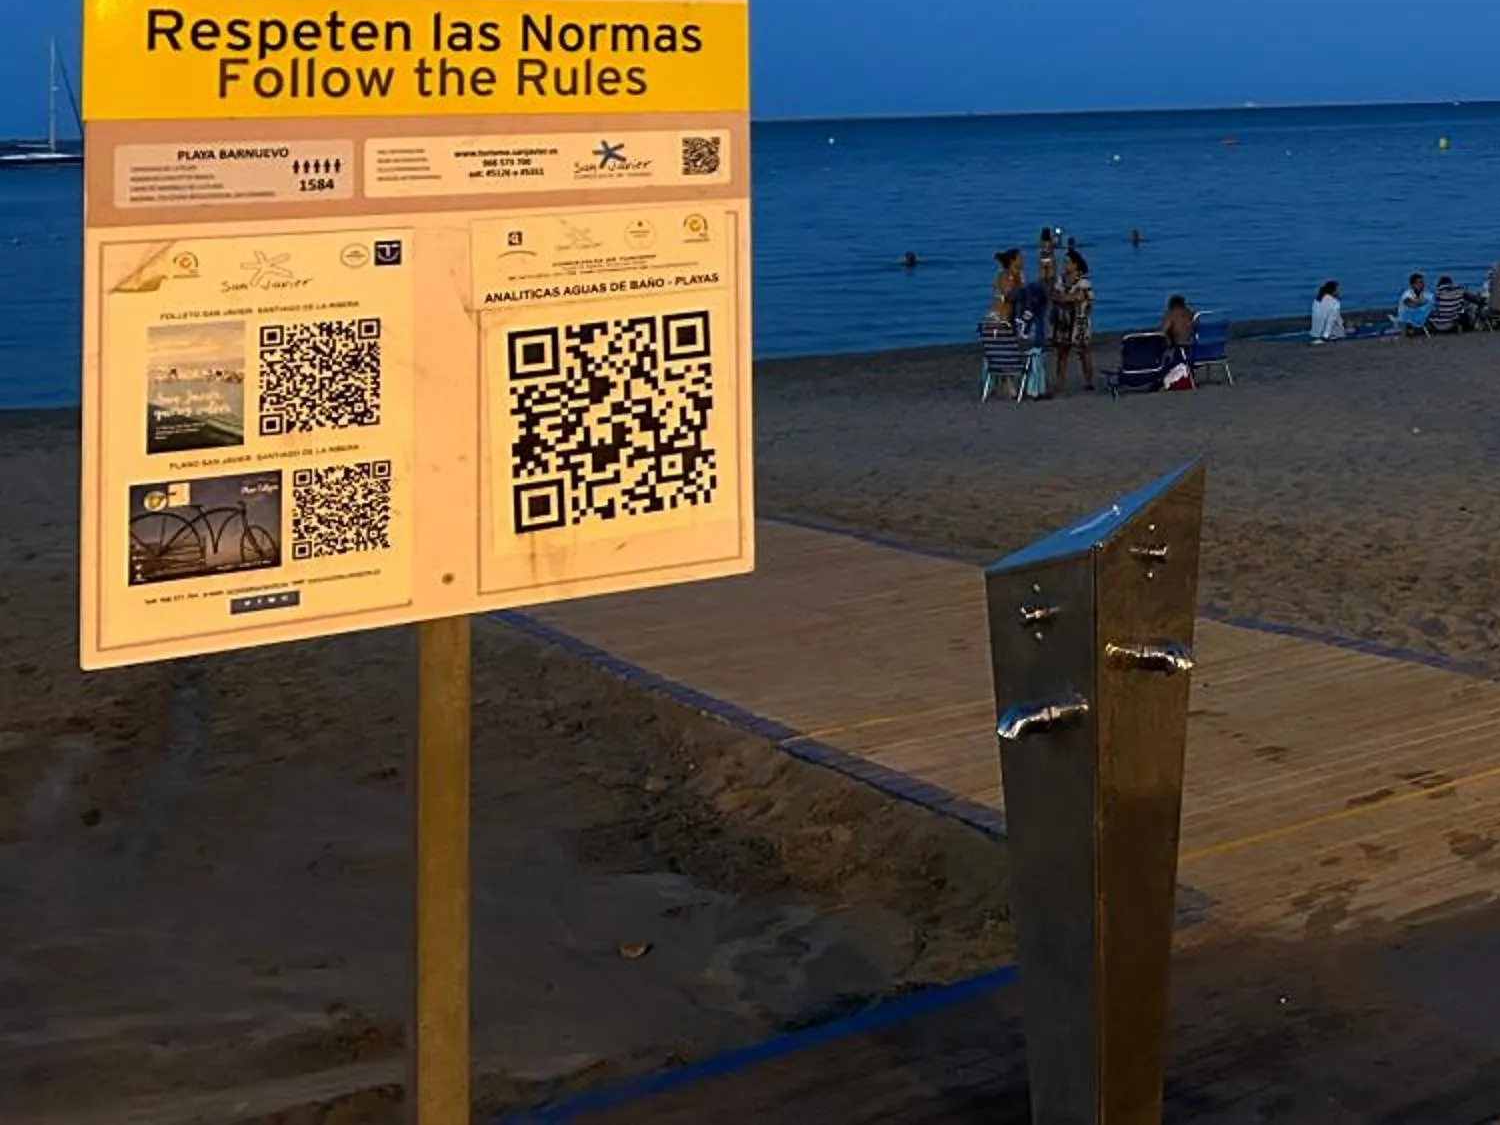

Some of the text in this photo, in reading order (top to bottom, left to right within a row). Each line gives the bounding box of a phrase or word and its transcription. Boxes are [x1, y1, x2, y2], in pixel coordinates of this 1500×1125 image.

[147, 9, 703, 58] Respeten las Normas
[218, 57, 648, 98] Follow the Rules
[177, 147, 289, 161] PLAYA BARNUEVO
[299, 178, 334, 192] 1584
[485, 286, 560, 303] ANALITICAS
[563, 283, 606, 296] AGUAS
[610, 281, 628, 292] DE
[630, 277, 665, 290] BAÑO
[674, 273, 719, 286] PLAYAS
